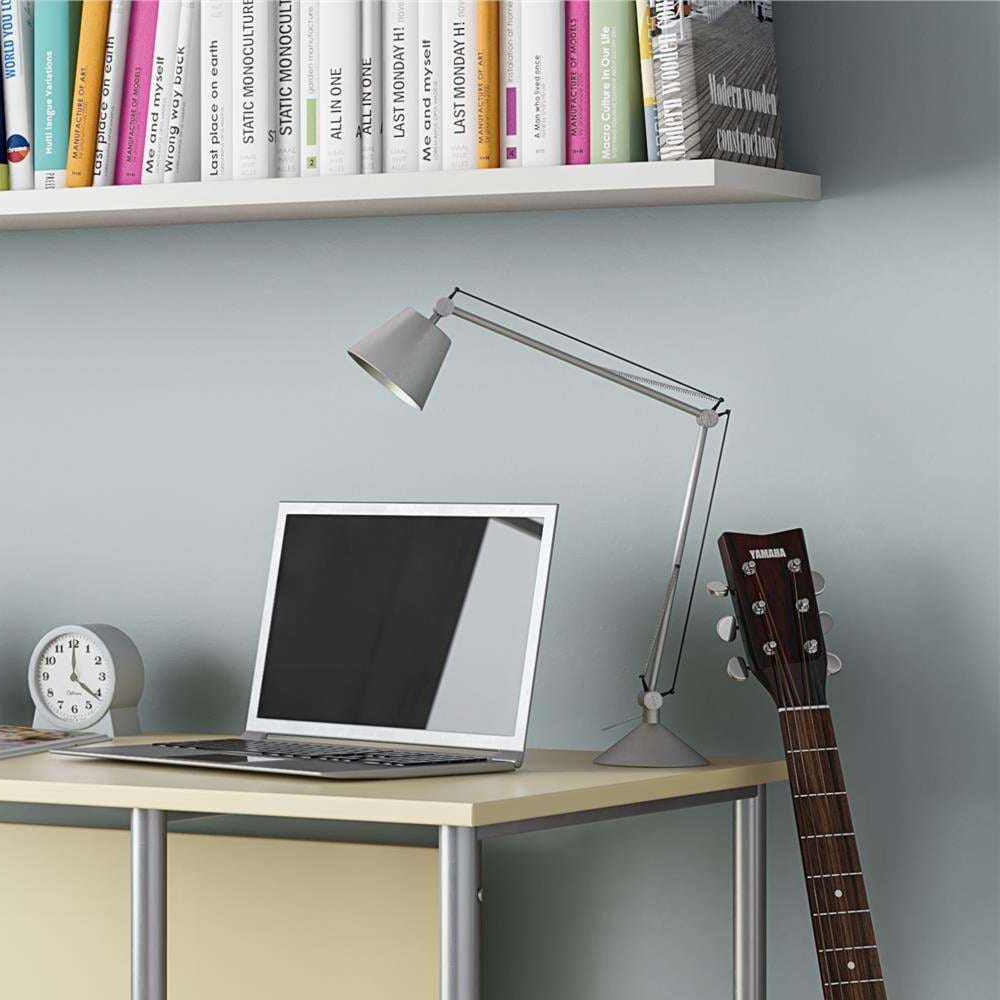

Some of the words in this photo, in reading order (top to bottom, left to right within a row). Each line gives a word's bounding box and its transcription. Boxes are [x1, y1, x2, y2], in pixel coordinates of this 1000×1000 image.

[2, 12, 14, 37] YOU
[601, 26, 611, 44] Life
[4, 40, 16, 80] WORLD
[173, 46, 186, 85] back
[209, 40, 219, 77] earth
[422, 39, 433, 92] myself
[453, 39, 466, 99] MONDAY
[571, 56, 578, 68] OF
[601, 47, 610, 67] Our
[653, 32, 681, 96] wooden
[44, 51, 53, 97] Variations
[133, 66, 142, 94] MODELS
[153, 56, 165, 107] myself
[330, 67, 342, 97] ONE
[361, 57, 372, 88] ONE
[393, 45, 405, 103] MONDAY
[477, 68, 484, 80] OF
[601, 69, 610, 80] In
[131, 96, 138, 107] OF
[210, 81, 219, 99] on
[361, 91, 372, 106] IN
[601, 83, 611, 121] Culture
[708, 73, 743, 110] Modern
[743, 84, 777, 116] wooden
[96, 103, 108, 145] place
[102, 79, 110, 97] on
[171, 91, 183, 120] way
[279, 86, 293, 136] STATIC
[330, 100, 342, 113] IN
[422, 98, 432, 130] and
[453, 102, 466, 135] LAST
[72, 100, 84, 159] MANUFACTURE
[78, 85, 85, 97] OF
[151, 112, 159, 144] and
[209, 104, 220, 144] place
[242, 101, 255, 144] STATIC
[330, 117, 342, 140] ALL
[361, 110, 372, 135] ALL
[393, 107, 405, 138] LAST
[126, 109, 137, 163] MANUFACTURE
[164, 125, 180, 173] Wrong
[422, 135, 432, 161] Me
[601, 125, 611, 160] Macro
[716, 124, 776, 160] constructions
[145, 148, 155, 174] Me
[209, 149, 219, 176] Last
[748, 547, 787, 559] YAMAHA
[55, 644, 64, 653] 11
[68, 639, 79, 649] 12
[85, 644, 90, 653] 1
[45, 656, 56, 665] 10
[94, 656, 102, 665] 2
[42, 672, 50, 681] 9
[98, 672, 106, 681] 3
[47, 688, 54, 697] 8
[58, 700, 64, 710] 7
[85, 701, 93, 710] 5
[96, 688, 102, 697] 4
[71, 705, 79, 714] 6
